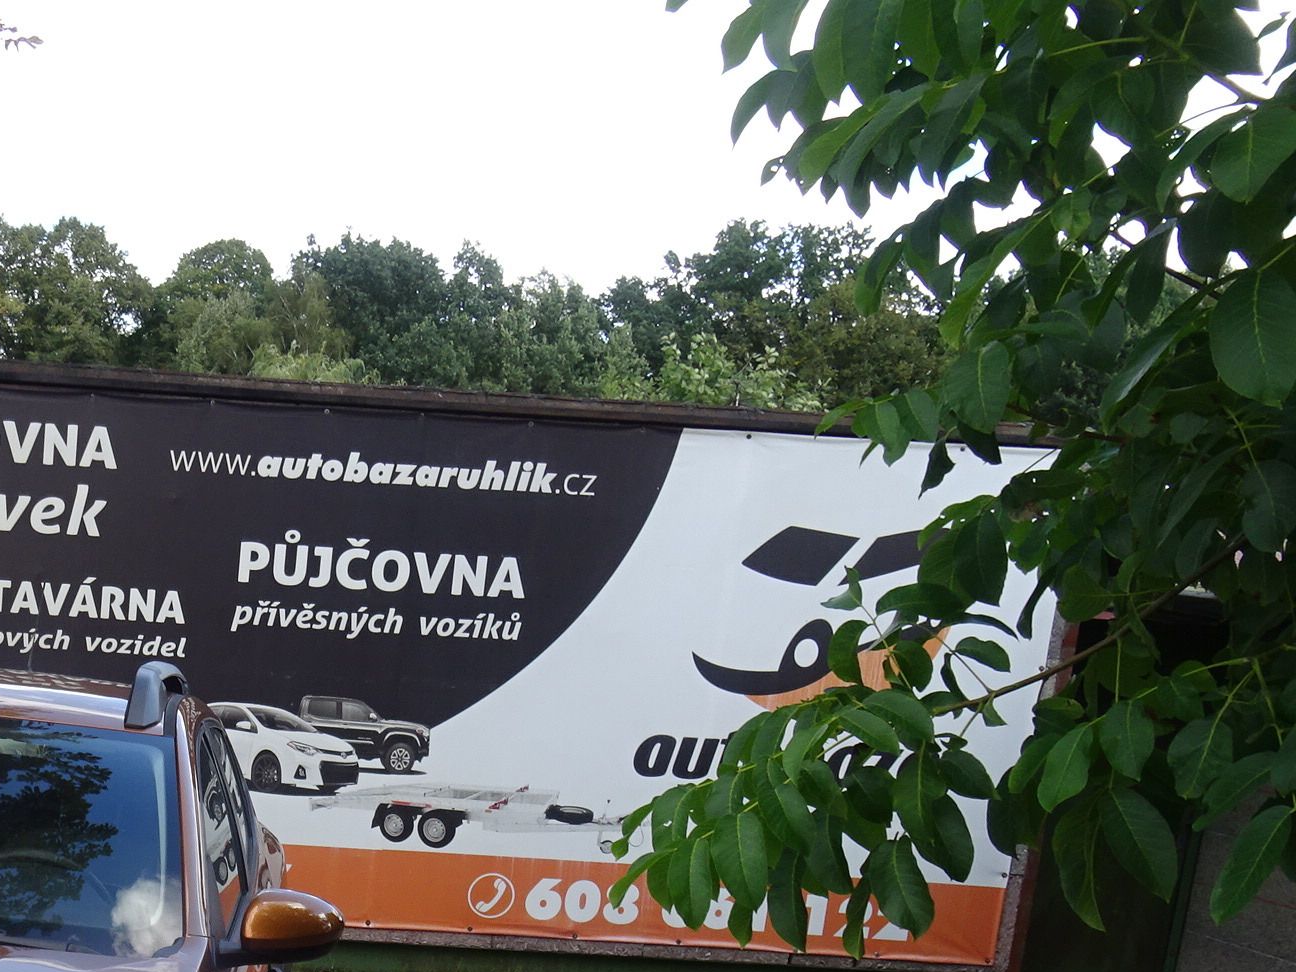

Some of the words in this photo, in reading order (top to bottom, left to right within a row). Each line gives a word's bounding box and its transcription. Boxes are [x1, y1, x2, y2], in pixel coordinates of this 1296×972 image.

[170, 449, 598, 496] www.autobazaruhlik.cz
[238, 530, 525, 599] PŮJČOVNA
[231, 600, 403, 639] přívěsných
[419, 612, 523, 641] vozíků
[85, 634, 187, 658] vozidel
[525, 878, 640, 925] 608
